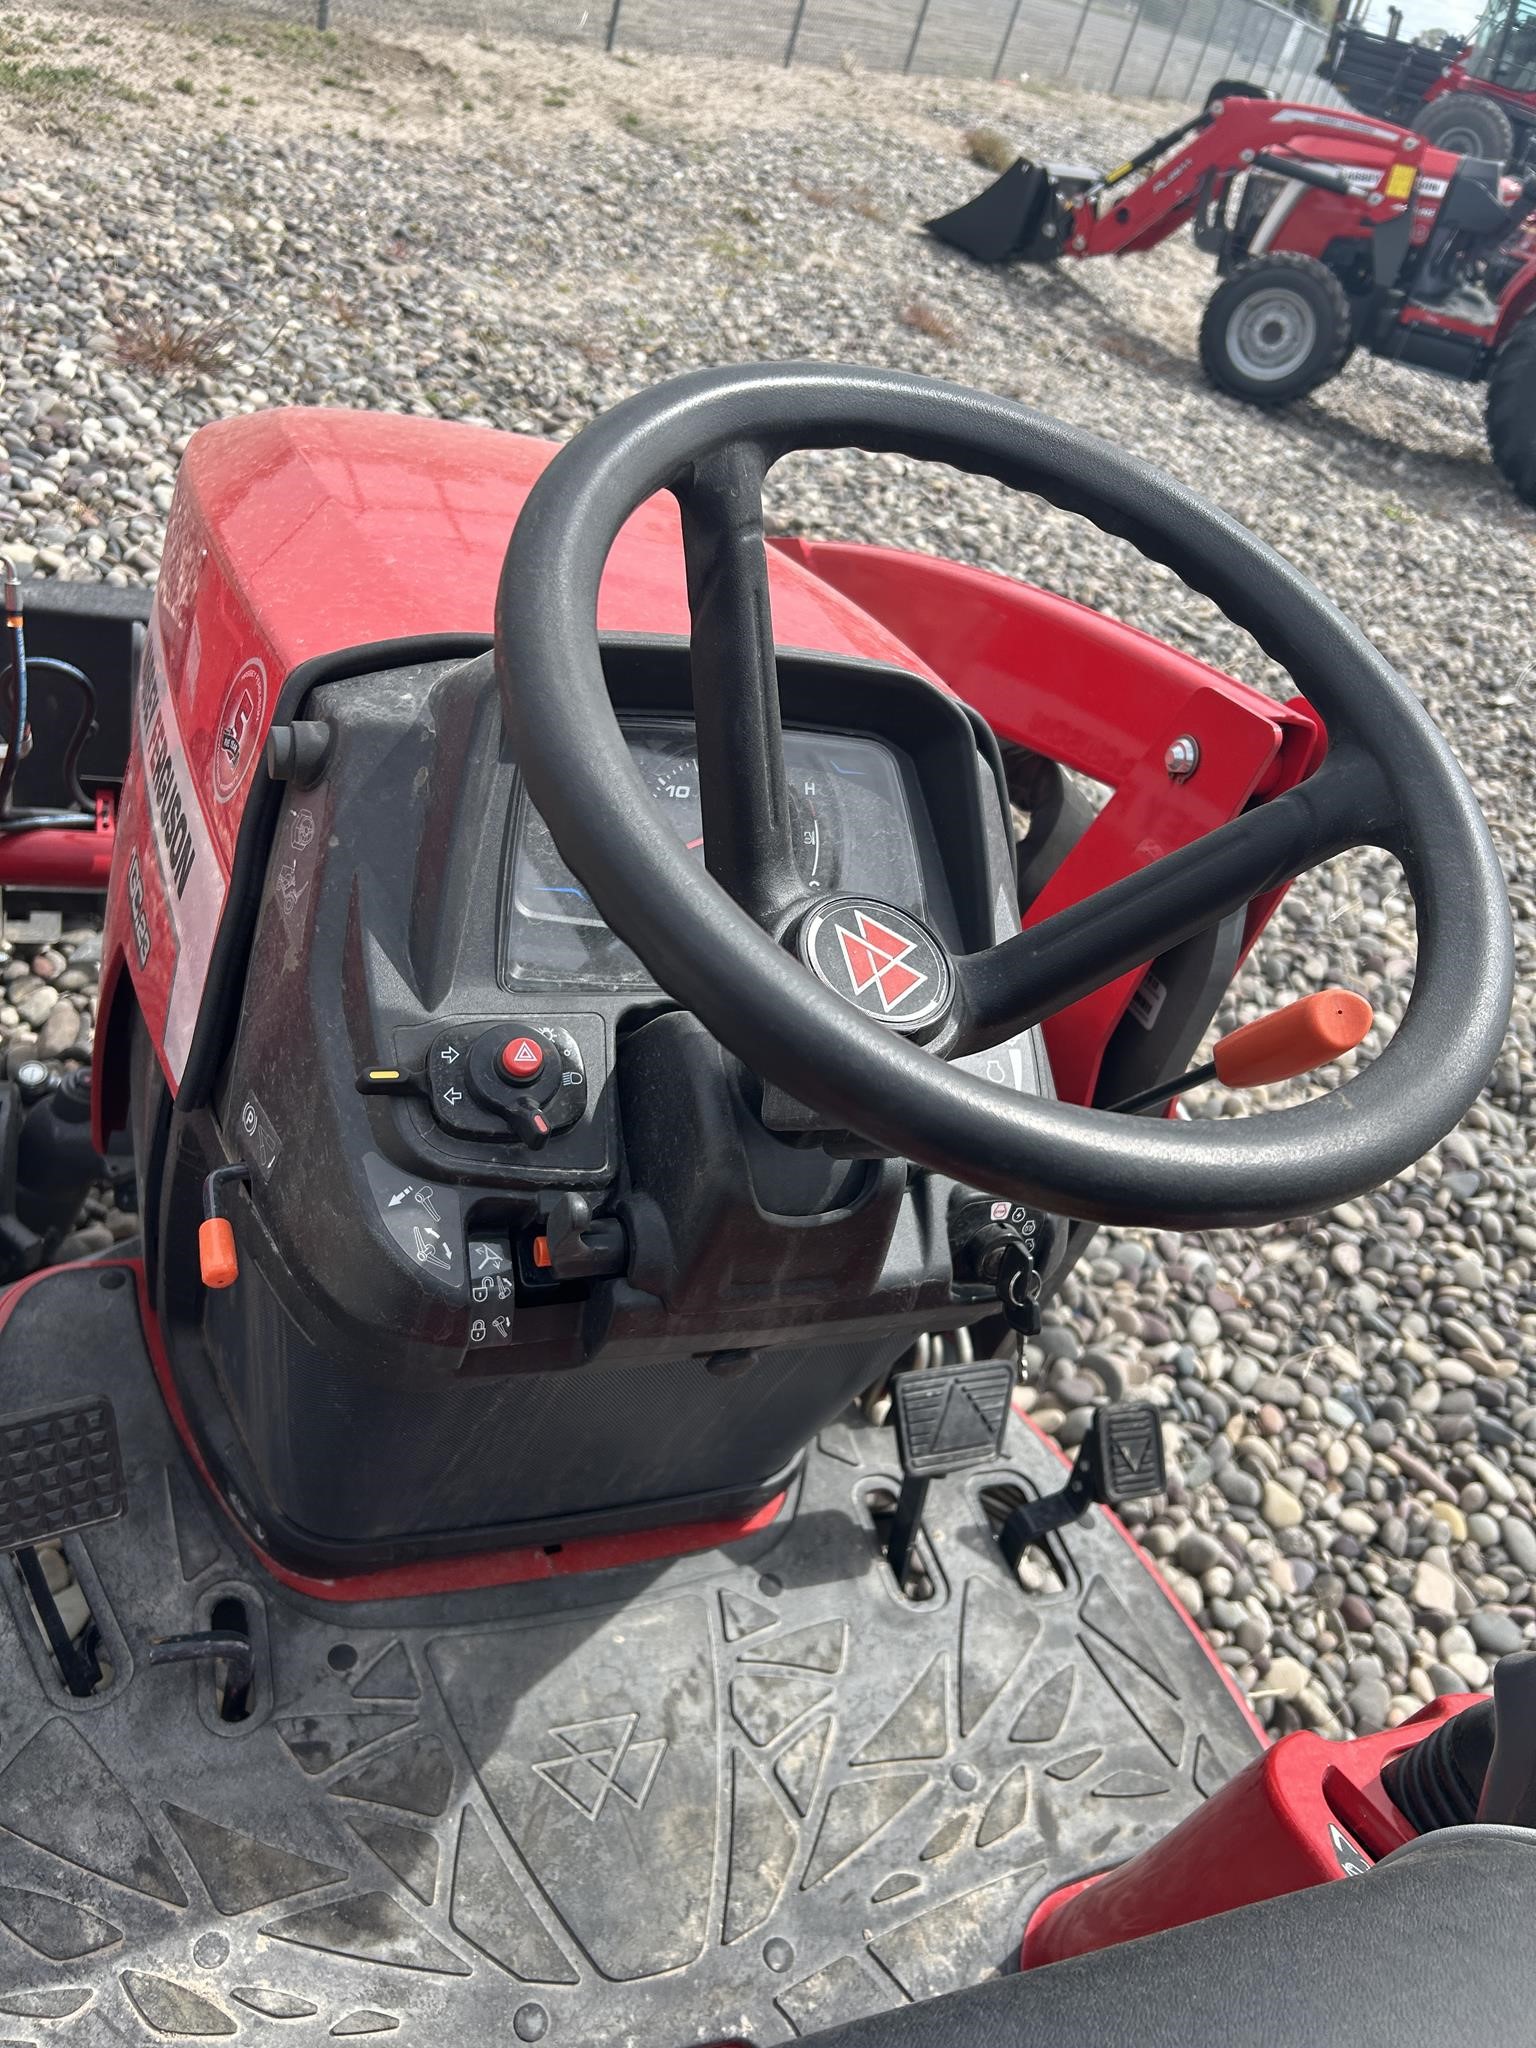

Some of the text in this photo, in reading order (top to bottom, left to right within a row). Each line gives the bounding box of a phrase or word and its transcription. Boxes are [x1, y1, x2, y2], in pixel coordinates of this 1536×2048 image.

[664, 785, 691, 799] 10
[804, 782, 816, 796] H
[148, 709, 196, 901] FERGUSON
